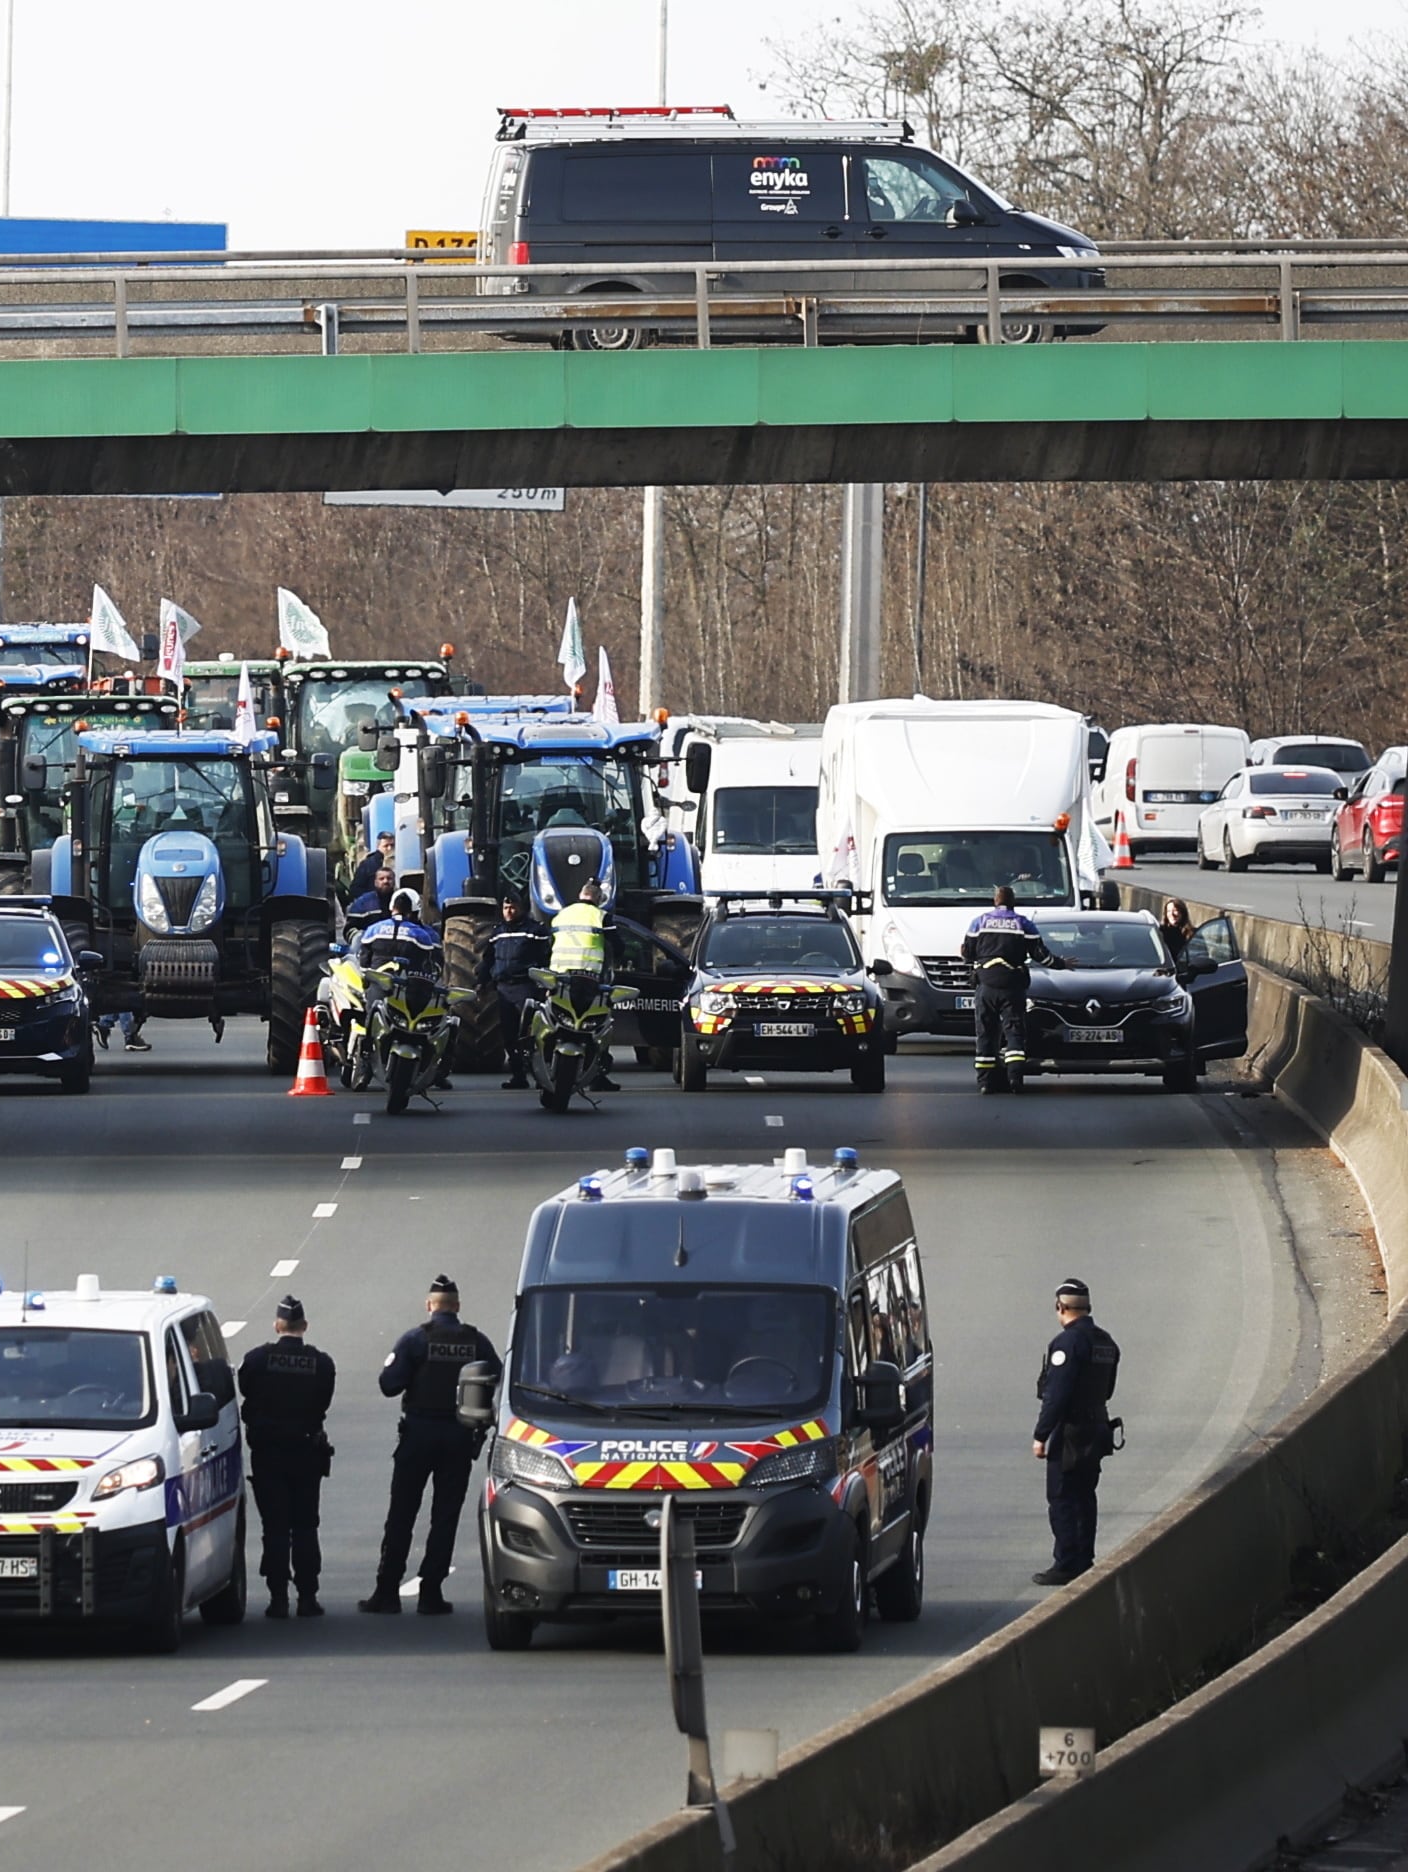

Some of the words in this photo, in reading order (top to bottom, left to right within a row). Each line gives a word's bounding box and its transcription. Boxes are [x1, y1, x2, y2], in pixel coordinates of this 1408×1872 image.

[750, 168, 808, 190] enyka
[984, 918, 1016, 929] POLICE
[407, 970, 437, 980] POLICE
[613, 999, 679, 1012] NDARMERIE
[430, 1344, 474, 1357] POLICE
[270, 1355, 315, 1370] POLICE
[601, 1440, 688, 1453] POLICE
[600, 1452, 687, 1461] NATIONALE
[1064, 1732, 1074, 1748] 6
[1045, 1751, 1091, 1767] +700
